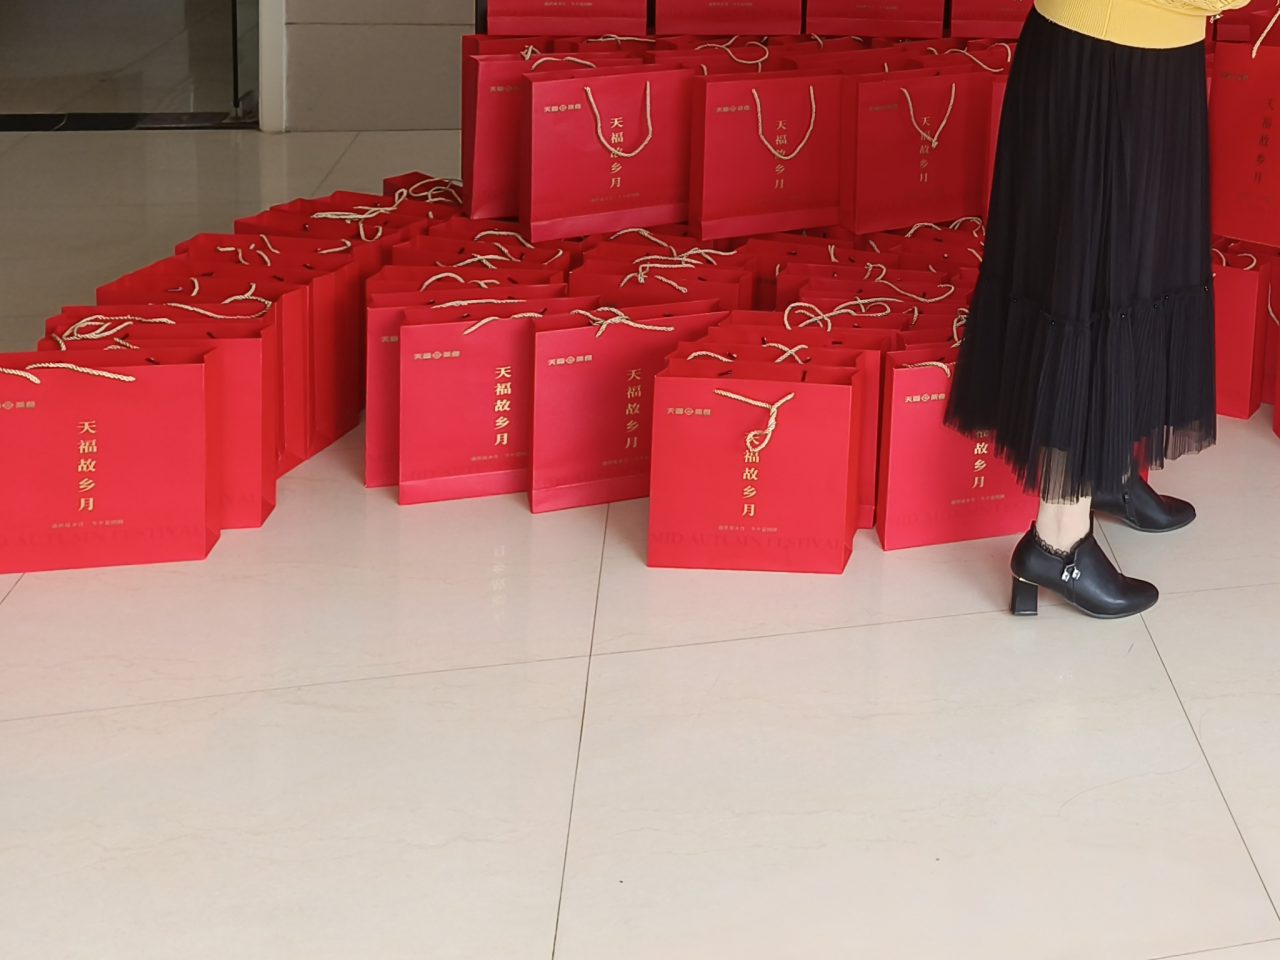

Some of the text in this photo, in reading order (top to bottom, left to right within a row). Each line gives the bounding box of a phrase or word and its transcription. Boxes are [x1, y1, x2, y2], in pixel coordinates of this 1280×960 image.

[494, 366, 512, 446] 天福故乡月
[625, 368, 642, 449] 天福故乡月
[77, 420, 97, 512] 天福故乡月
